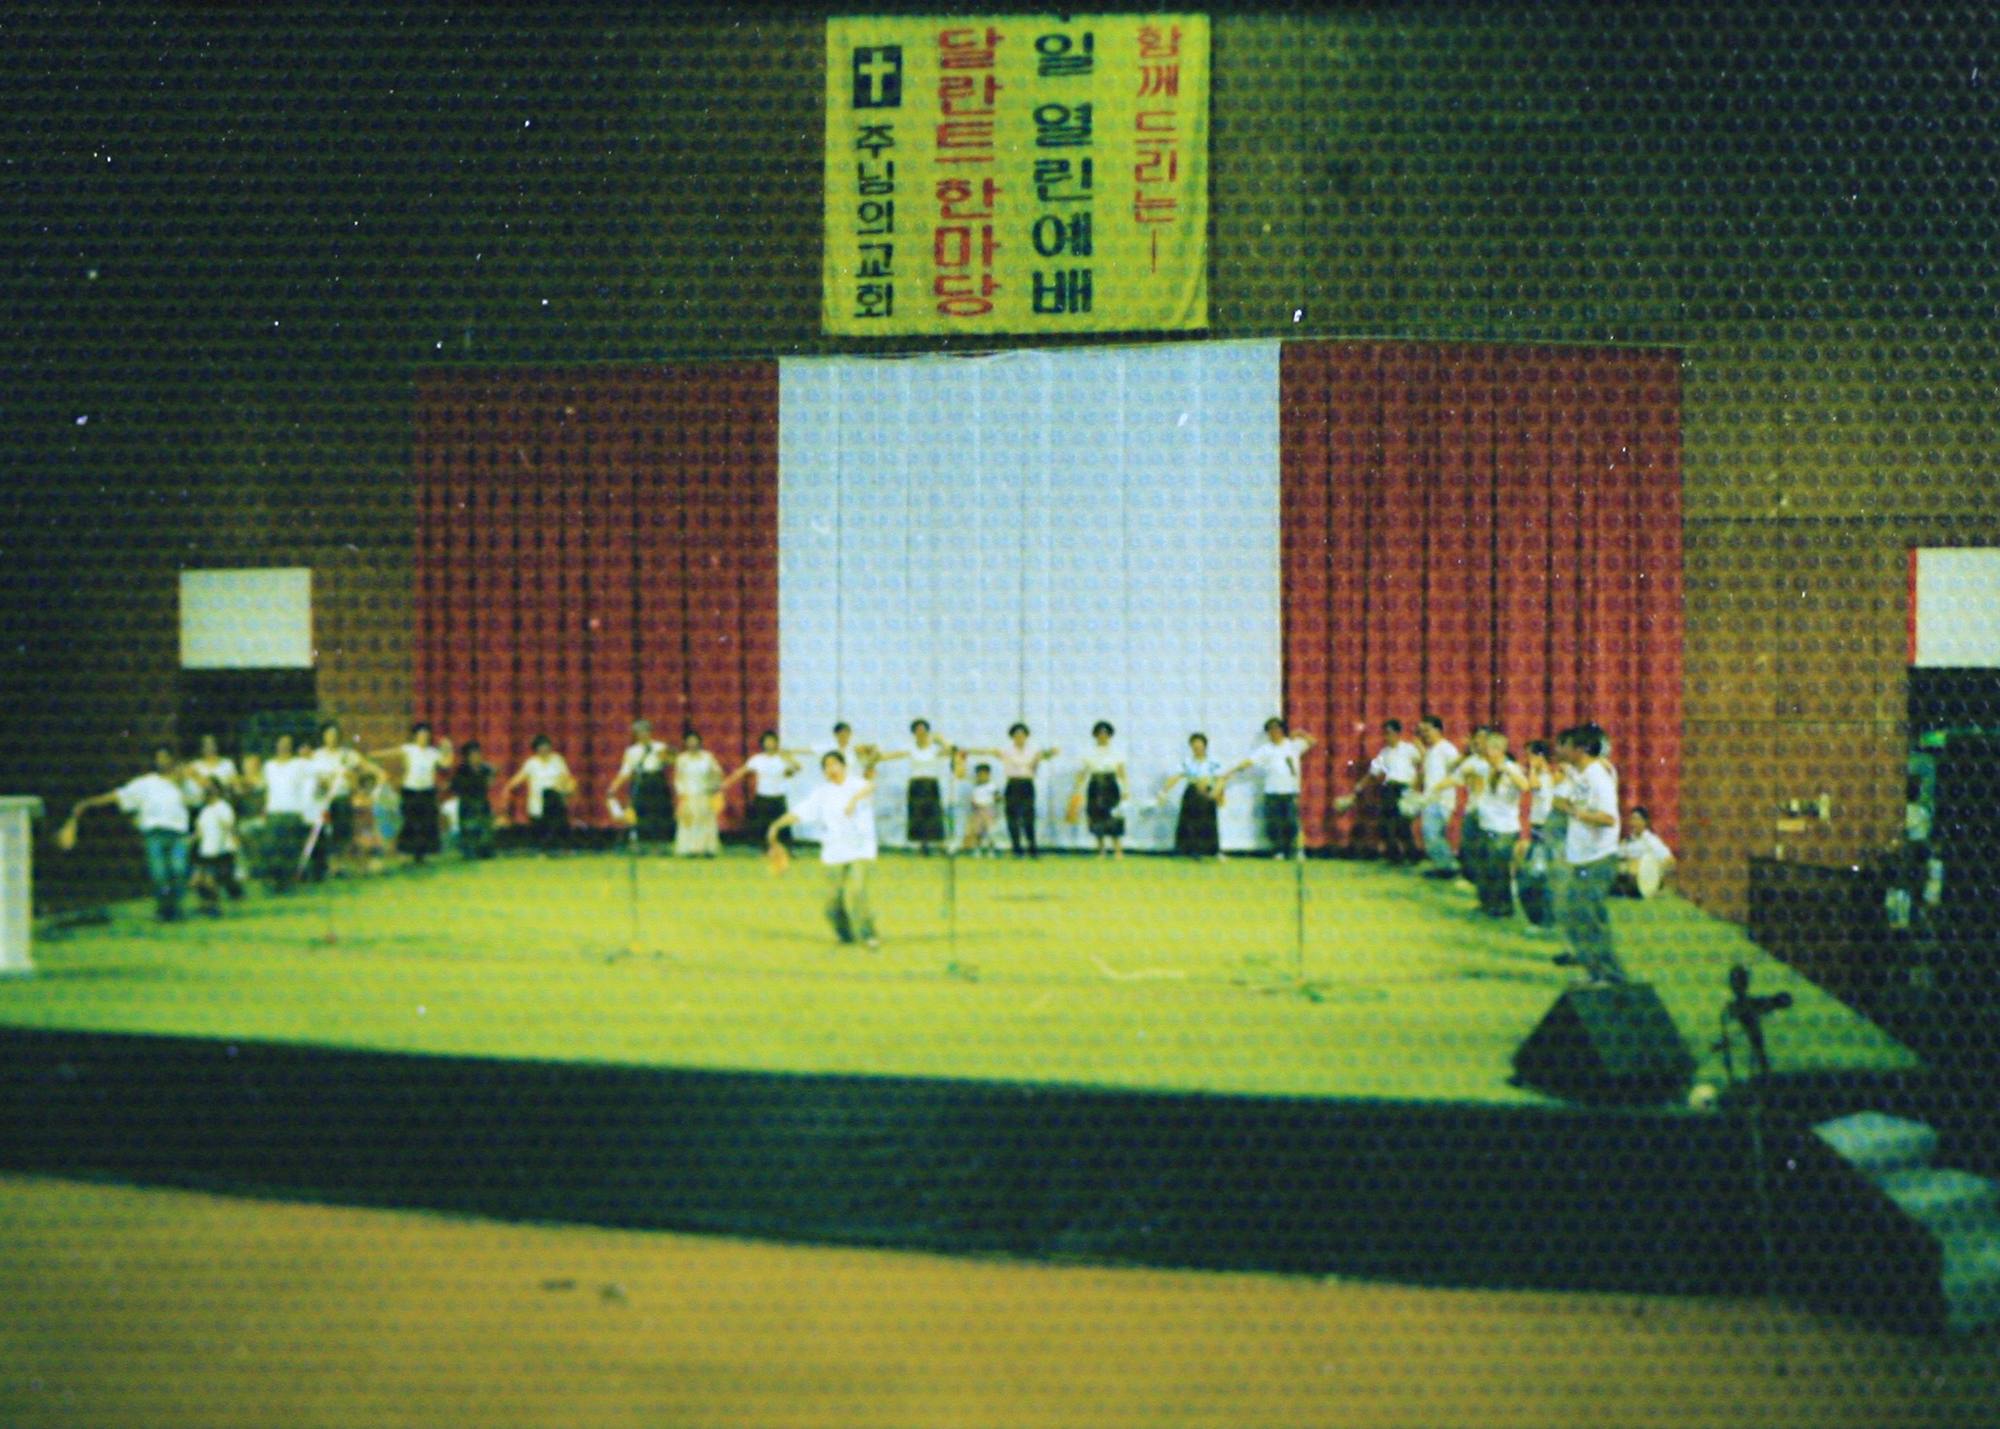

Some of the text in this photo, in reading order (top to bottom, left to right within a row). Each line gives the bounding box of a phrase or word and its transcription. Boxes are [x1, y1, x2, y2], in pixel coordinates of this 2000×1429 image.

[933, 26, 1004, 318] 달란트 한마당
[1031, 102, 1094, 315] 열린예배
